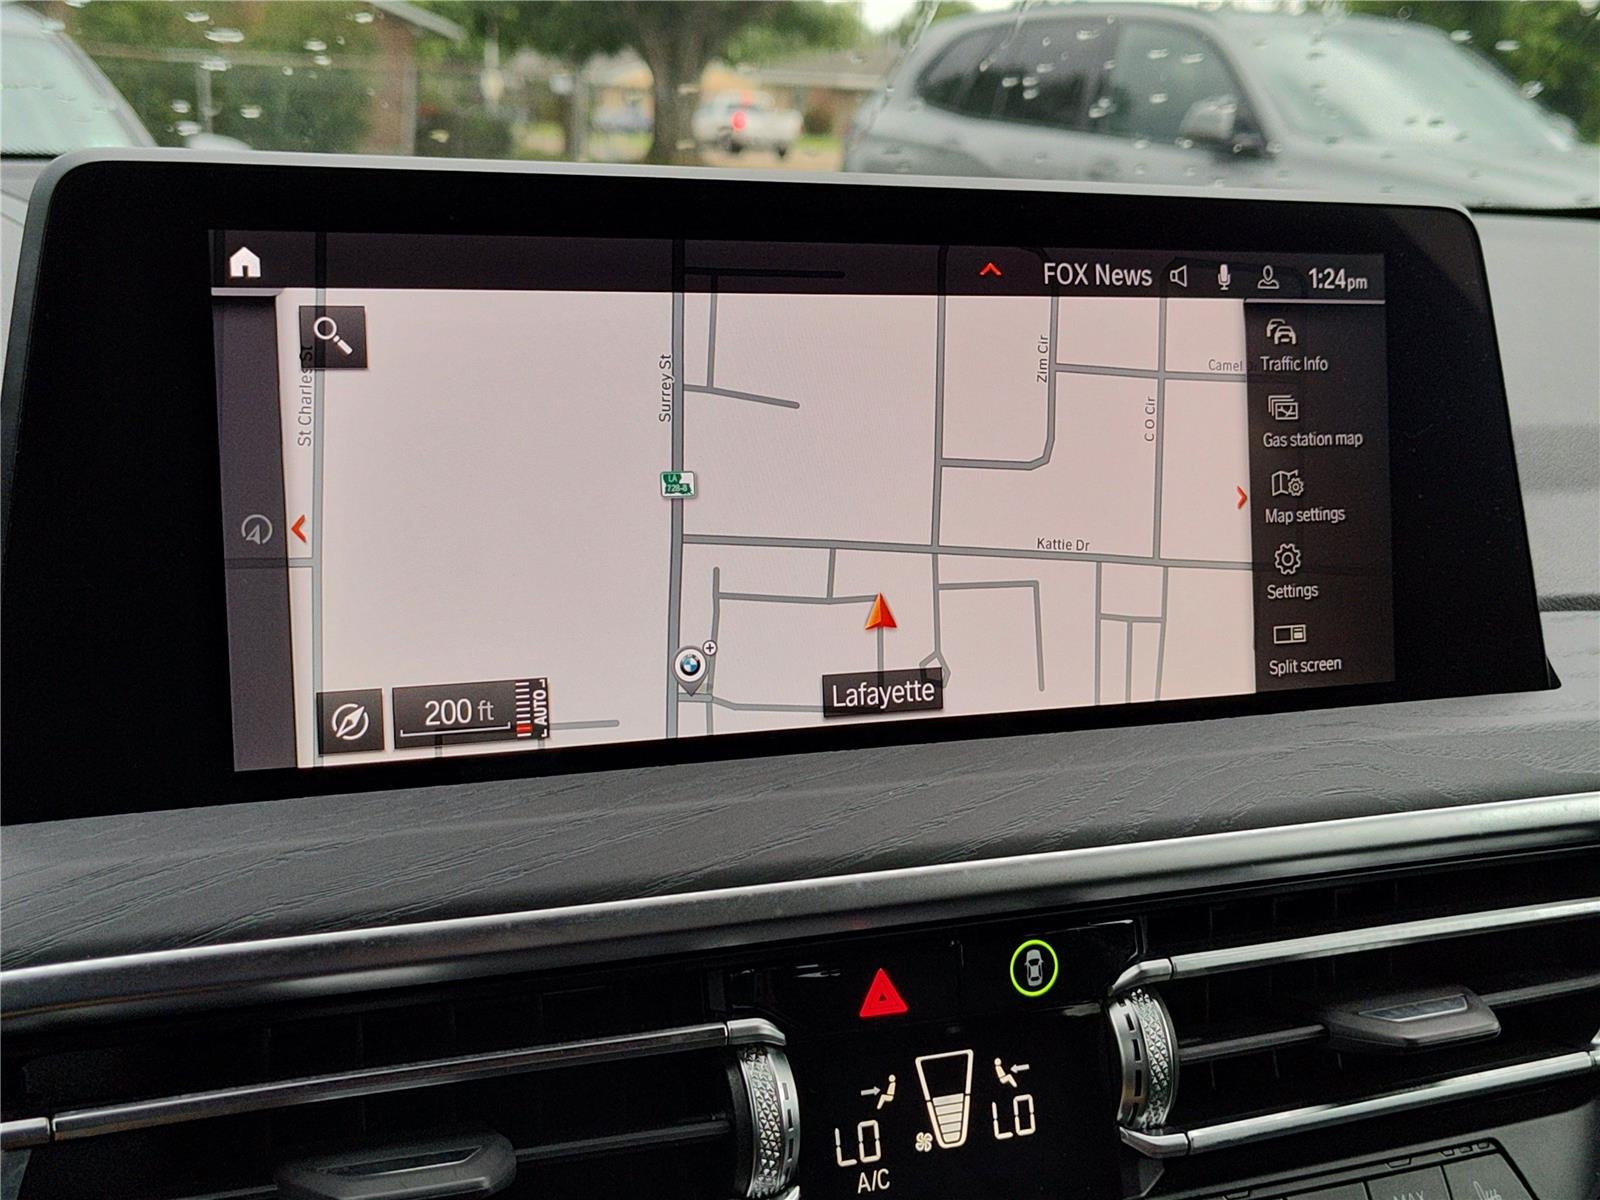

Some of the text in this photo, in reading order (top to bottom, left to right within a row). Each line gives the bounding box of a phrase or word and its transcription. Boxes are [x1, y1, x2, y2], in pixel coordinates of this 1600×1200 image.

[1043, 262, 1153, 286] FOX News
[1308, 267, 1368, 292] 1:24pm
[1036, 334, 1049, 383] Zim Cir
[1208, 358, 1243, 372] Camel
[1259, 355, 1302, 372] Traffic
[1303, 355, 1329, 372] Info
[297, 367, 313, 426] Charles
[658, 354, 674, 423] Surrey St
[1144, 396, 1156, 415] Cir
[297, 430, 312, 447] St
[1262, 431, 1364, 448] Gas station map
[1265, 506, 1346, 526] Map settings
[1036, 537, 1091, 552] Kattie Dr
[1266, 583, 1319, 600] Settings
[1269, 658, 1343, 677] Split screen
[831, 679, 937, 710] Lafayette
[424, 698, 495, 726] 200 ft
[532, 689, 548, 726] AUTO
[856, 1167, 892, 1195] A/C
